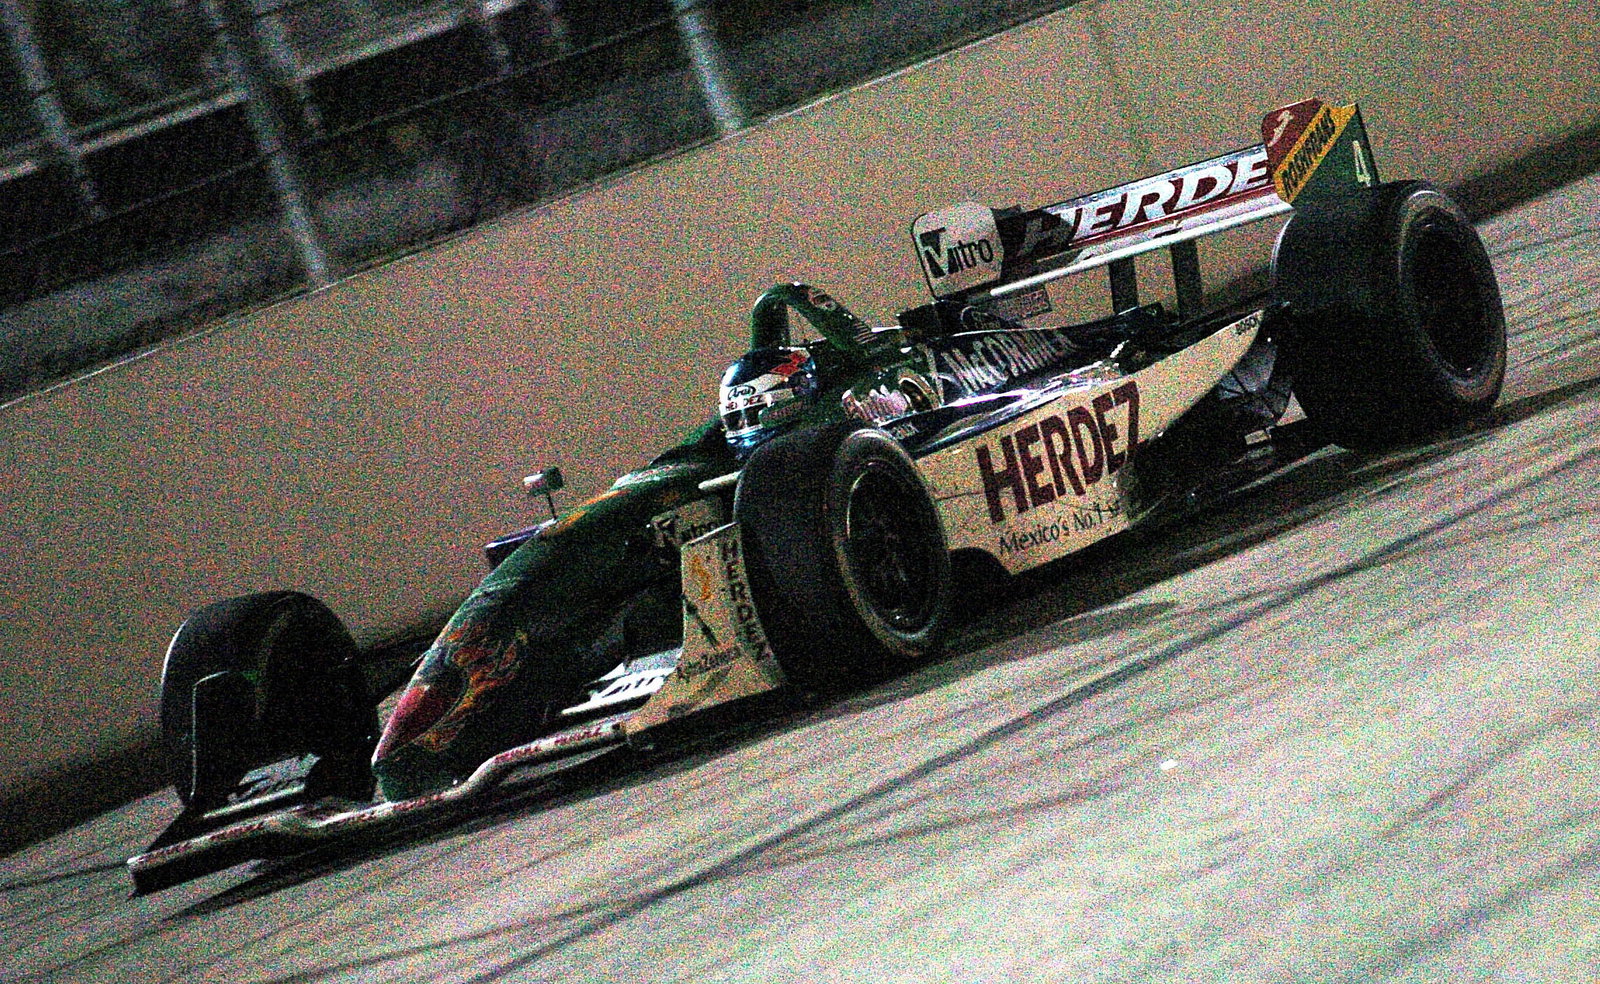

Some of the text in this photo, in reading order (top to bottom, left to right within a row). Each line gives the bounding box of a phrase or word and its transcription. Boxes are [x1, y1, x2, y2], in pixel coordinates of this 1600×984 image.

[1014, 151, 1270, 258] HERDE
[1352, 140, 1371, 187] 4
[975, 380, 1139, 524] HERDEZ
[1000, 515, 1070, 553] Mexico's
[722, 541, 774, 662] HERDEZ
